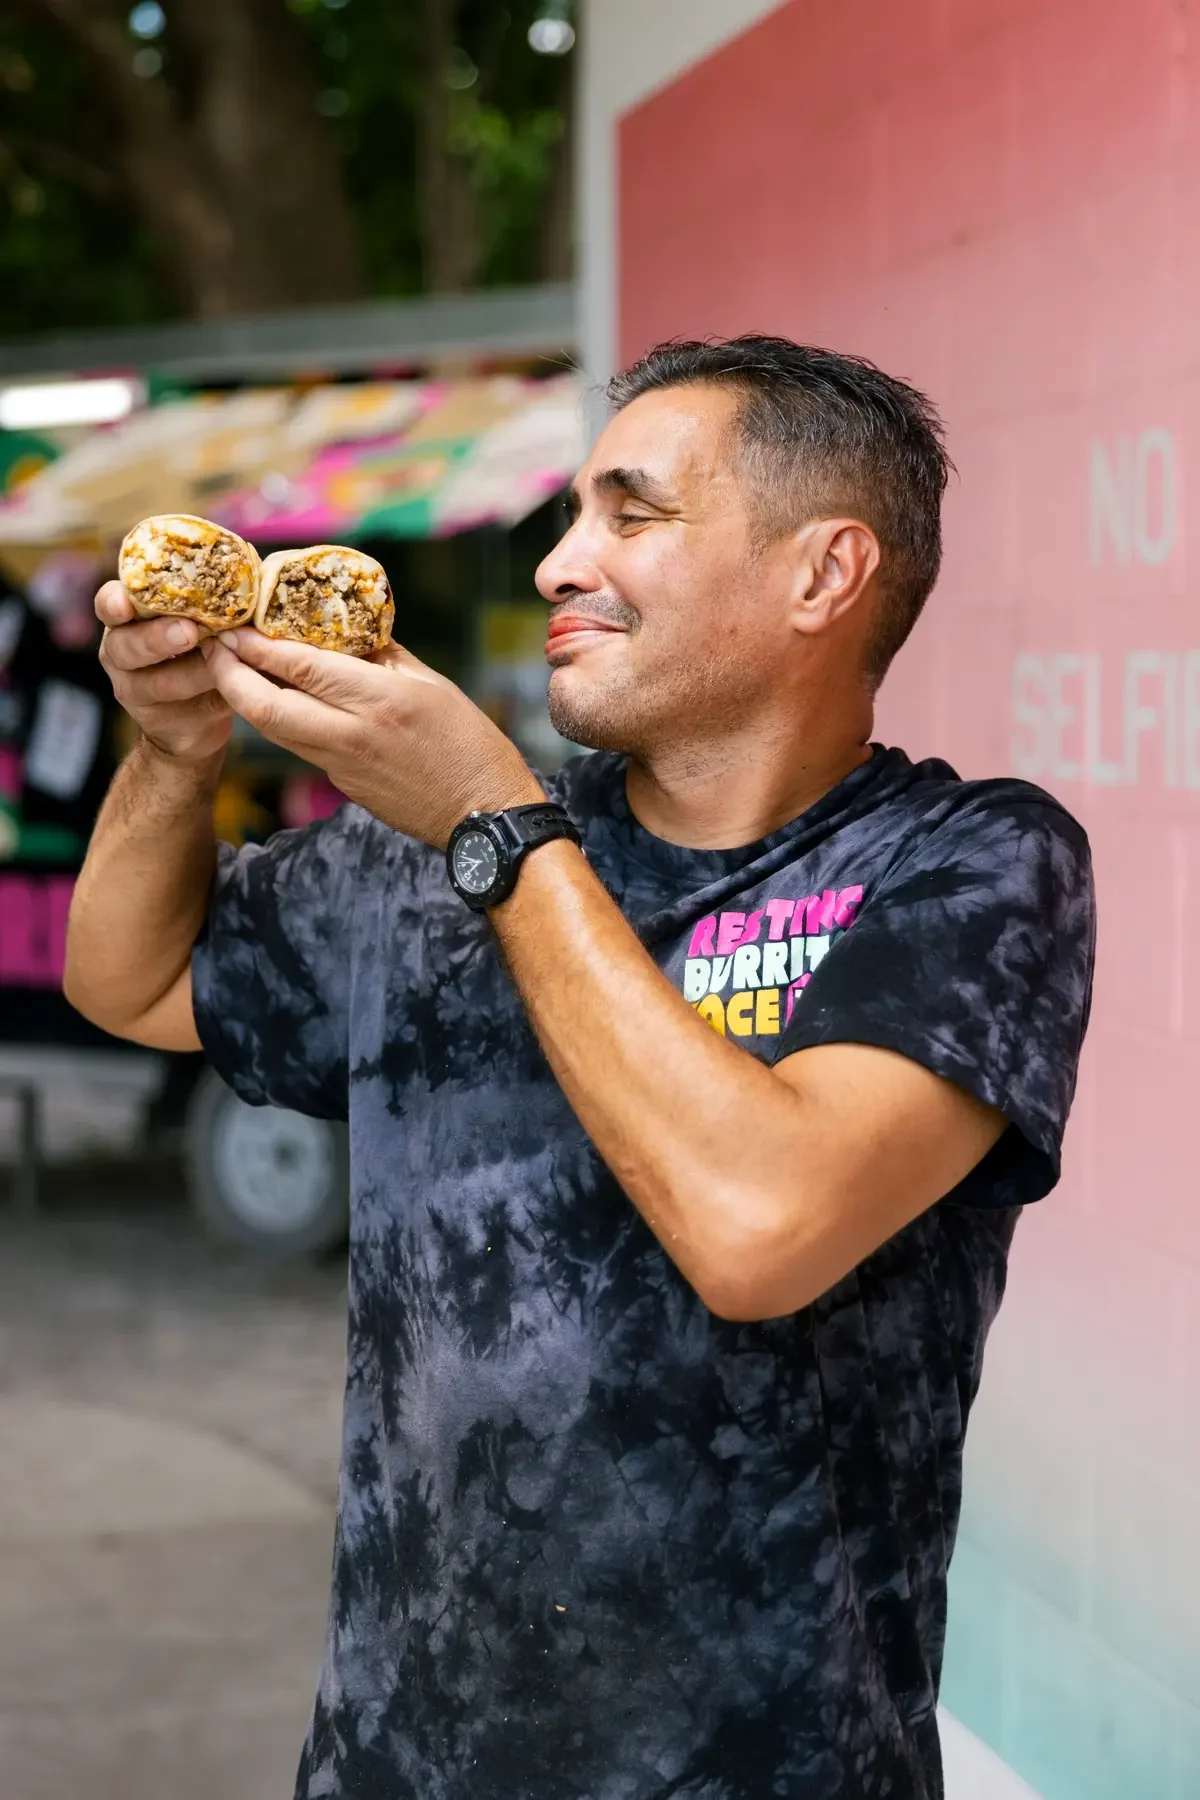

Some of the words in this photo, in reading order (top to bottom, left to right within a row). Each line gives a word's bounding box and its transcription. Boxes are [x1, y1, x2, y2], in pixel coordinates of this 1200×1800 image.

[1090, 427, 1174, 569] NO
[687, 884, 863, 957] RESTING
[684, 934, 830, 1002] BURRIT
[692, 988, 780, 1037] ACE
